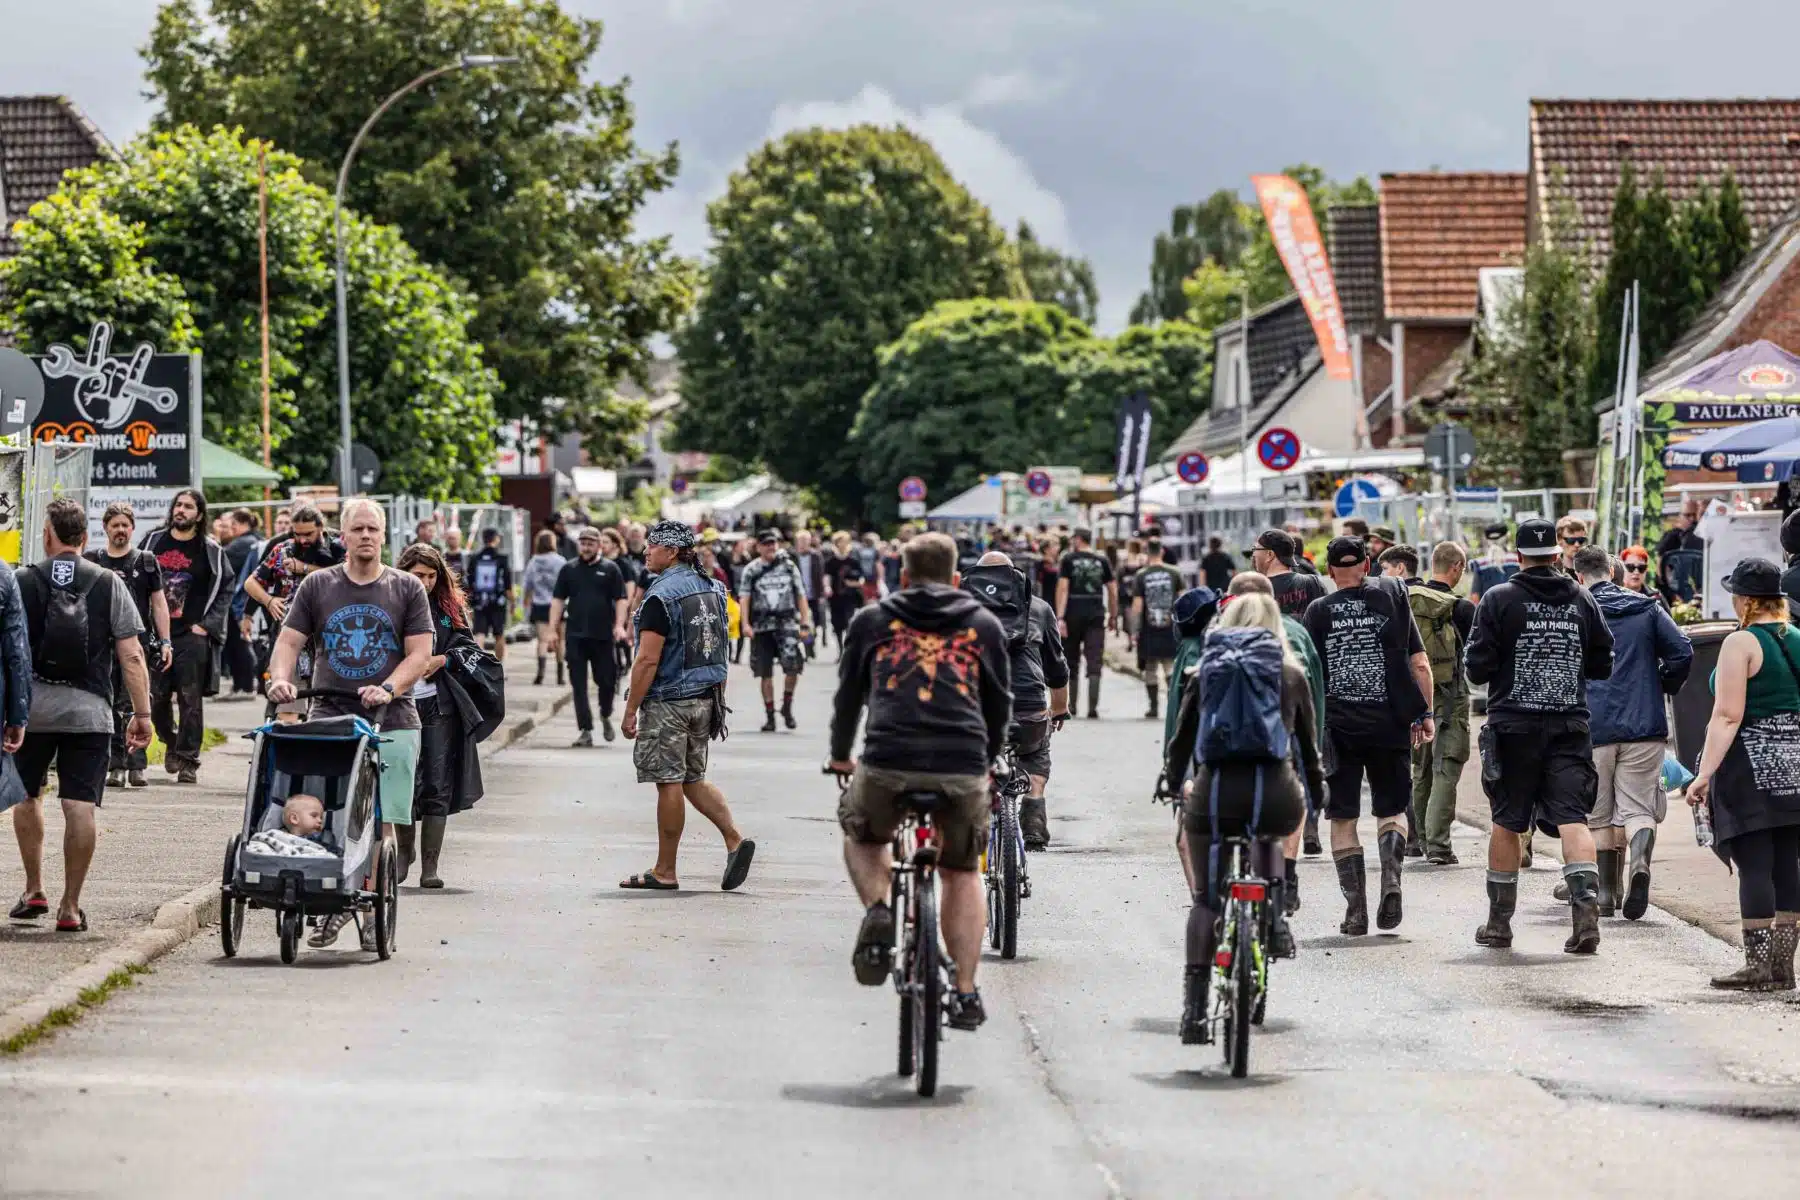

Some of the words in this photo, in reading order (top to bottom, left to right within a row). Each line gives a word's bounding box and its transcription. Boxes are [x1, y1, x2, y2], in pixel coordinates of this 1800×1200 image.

[107, 461, 158, 479] Schenk
[1331, 618, 1354, 629] IRON
[1526, 620, 1547, 631] IRON
[1548, 620, 1579, 633] MAIDEN
[328, 655, 366, 677] ORKING
